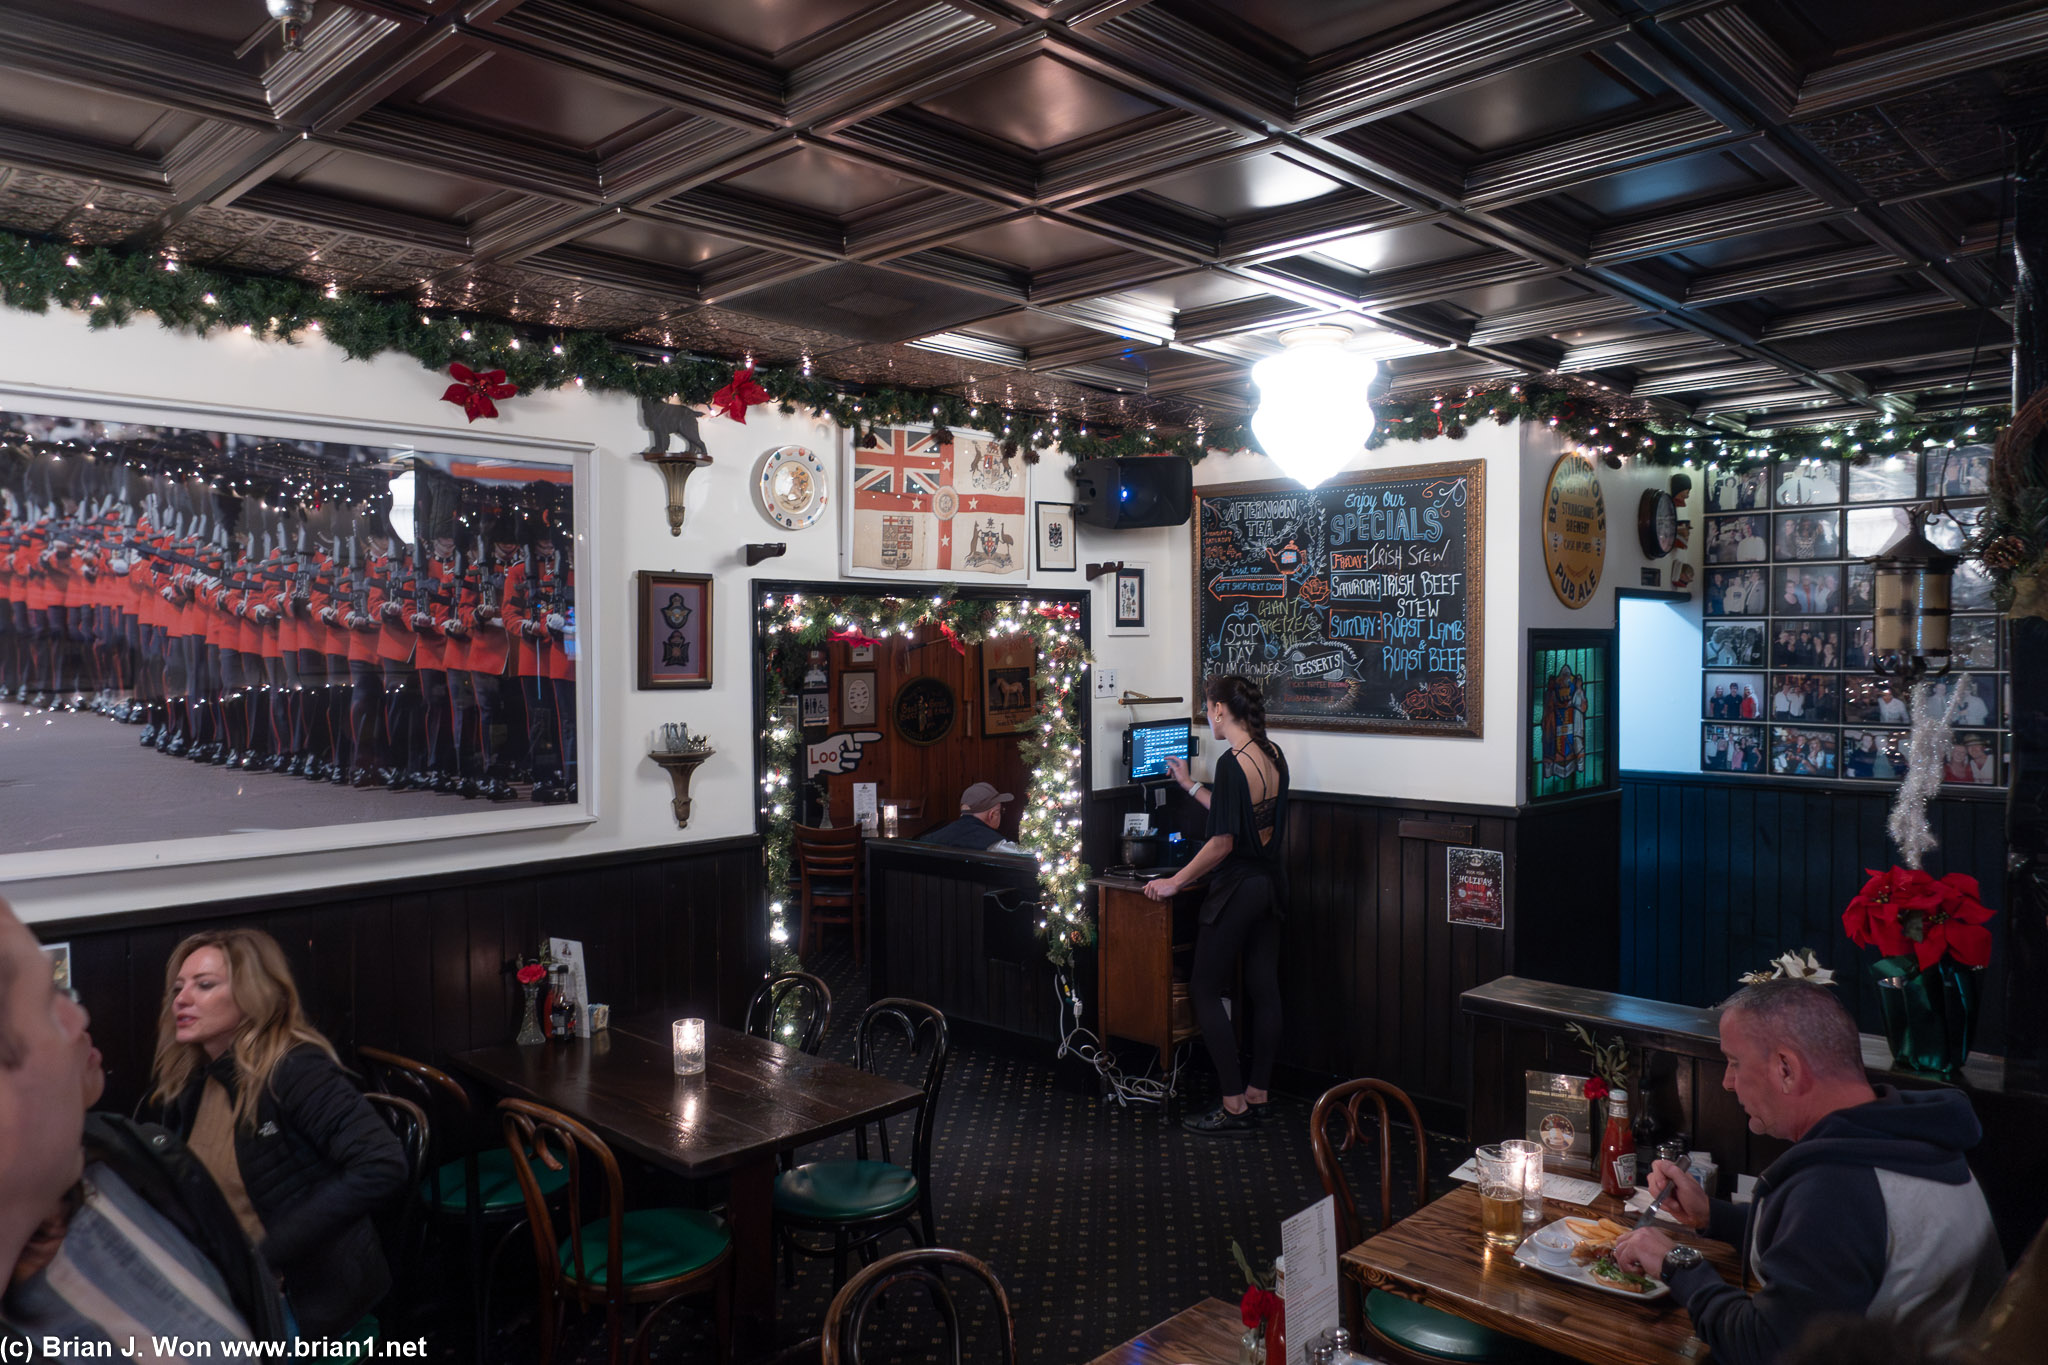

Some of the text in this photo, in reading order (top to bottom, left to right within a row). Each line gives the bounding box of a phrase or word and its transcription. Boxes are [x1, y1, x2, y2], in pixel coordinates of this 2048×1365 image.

[1225, 499, 1297, 521] AFTERNOON
[1345, 491, 1406, 514] Enjoy Our
[1246, 520, 1274, 537] TEA
[1330, 507, 1443, 545] SPECIALS
[1408, 539, 1451, 566] STEW
[1215, 583, 1230, 591] GIFT
[1248, 583, 1264, 591] NEXT
[1266, 582, 1283, 591] DOOR
[1420, 571, 1462, 597] BEEF
[1555, 561, 1597, 602] PUB ALE
[1258, 597, 1300, 617] GIANT
[1397, 598, 1440, 618] STEW
[1226, 623, 1260, 644] SOUP
[1382, 613, 1426, 644] ROAST
[1428, 619, 1465, 647] LAMB
[1228, 645, 1254, 663] DAY
[1419, 640, 1427, 650] &
[1239, 660, 1283, 675] CHOWDER
[1294, 653, 1341, 676] DESSERTS
[1382, 646, 1467, 680] ROAST BEEF
[1459, 875, 1493, 887] HOLIDAY
